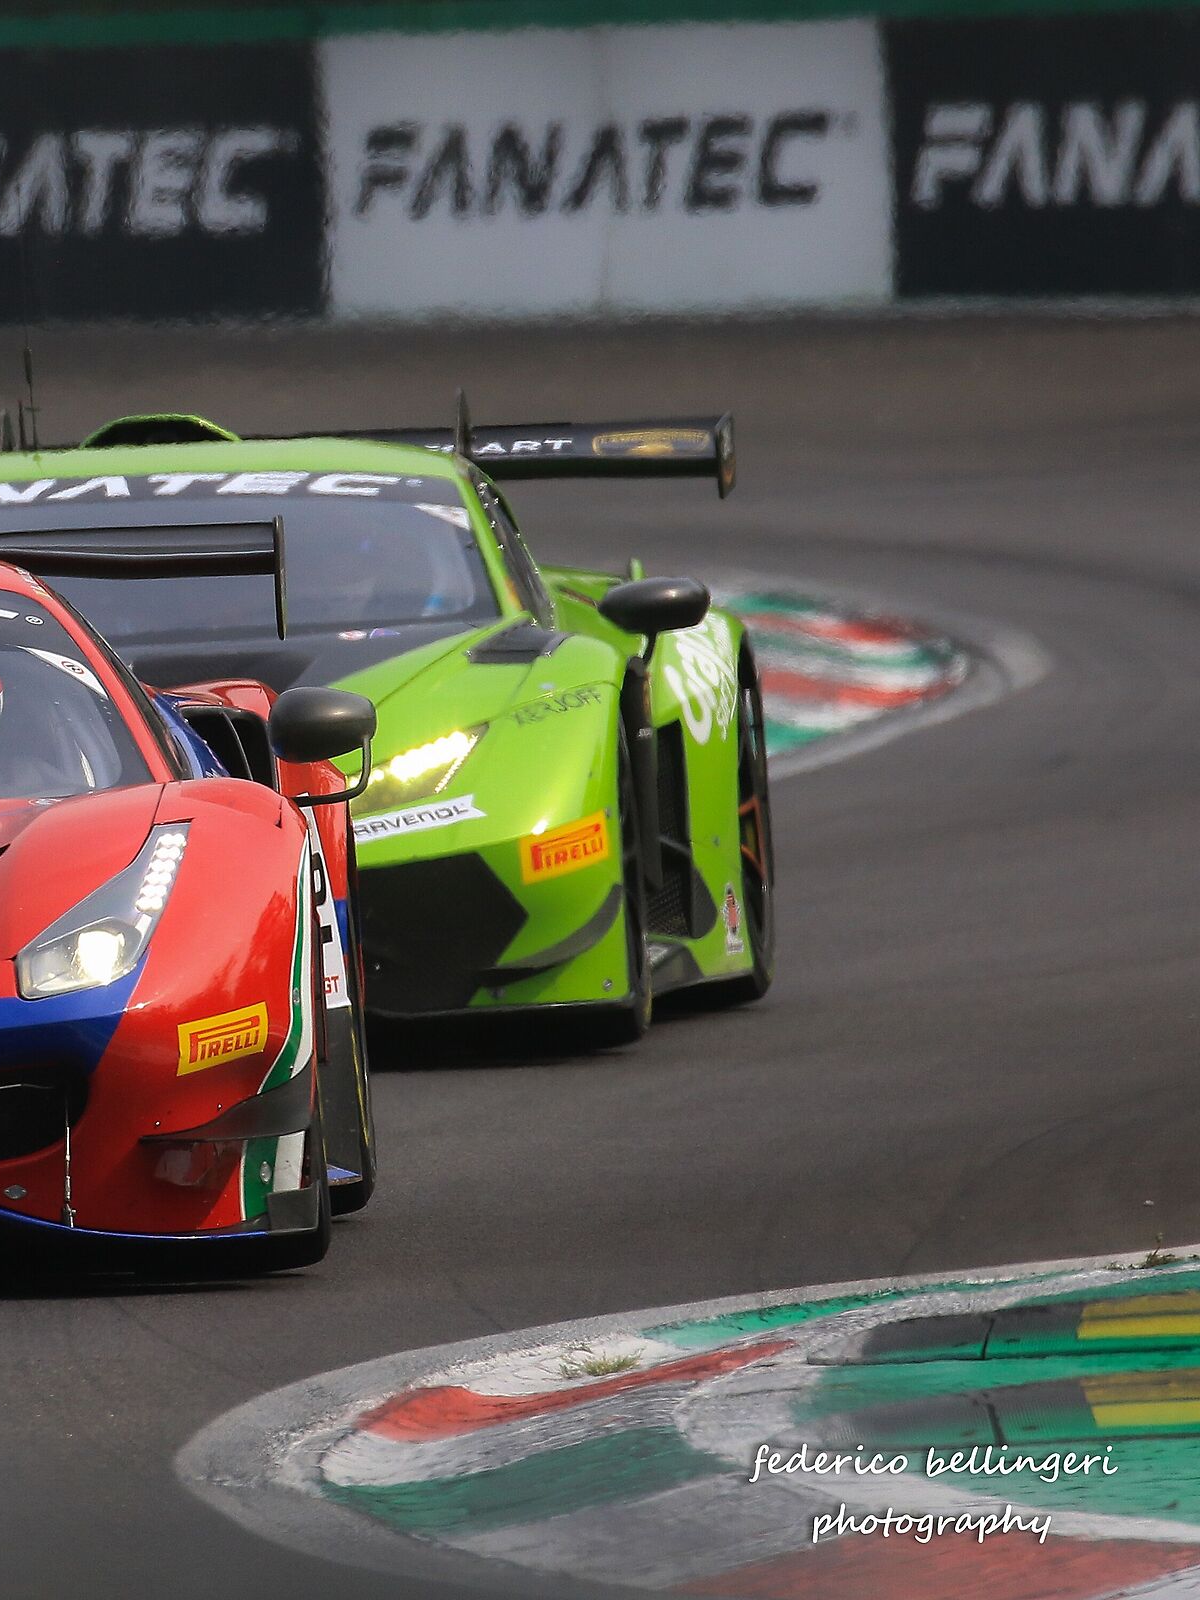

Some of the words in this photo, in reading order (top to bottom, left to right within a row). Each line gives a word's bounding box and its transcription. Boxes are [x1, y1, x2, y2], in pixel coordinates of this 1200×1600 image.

[356, 109, 830, 221] FANATEC
[912, 100, 1200, 210] FANA
[531, 822, 605, 872] PIRELLI
[189, 1016, 260, 1063] PIRELLI
